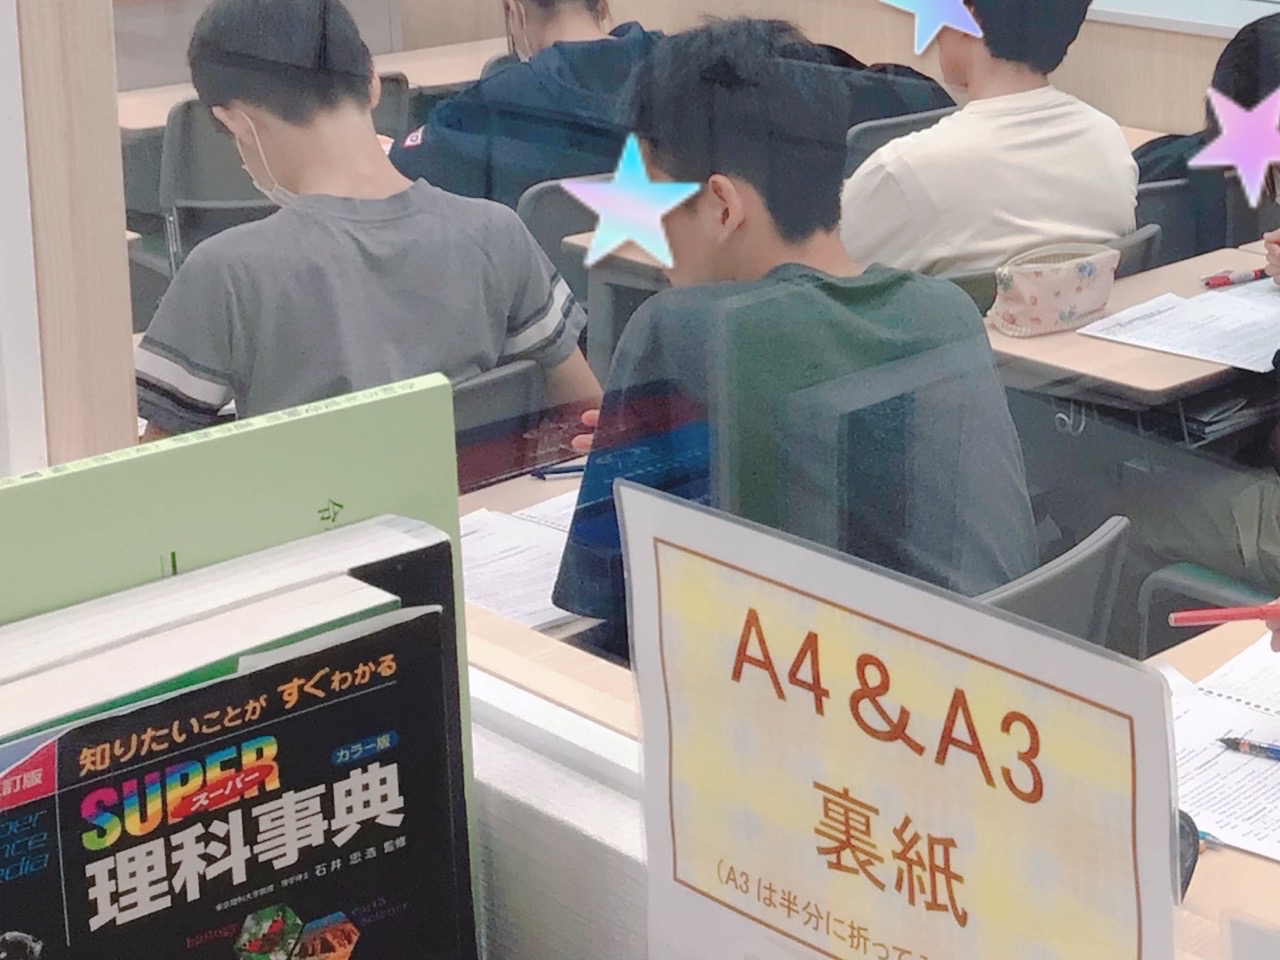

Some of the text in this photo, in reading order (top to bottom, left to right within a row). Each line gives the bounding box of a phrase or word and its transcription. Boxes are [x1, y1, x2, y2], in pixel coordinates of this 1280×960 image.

[78, 653, 397, 777] 知りたいことが すぐわかる
[336, 737, 391, 763] カラー版
[731, 607, 1044, 804] A4&A3
[1, 768, 43, 797] 訂版
[80, 735, 281, 852] SUPER
[190, 770, 260, 812] スーパー
[84, 760, 405, 932] 理科事典
[813, 780, 967, 928] 裏紙
[717, 858, 928, 959] (A3は半分に折って
